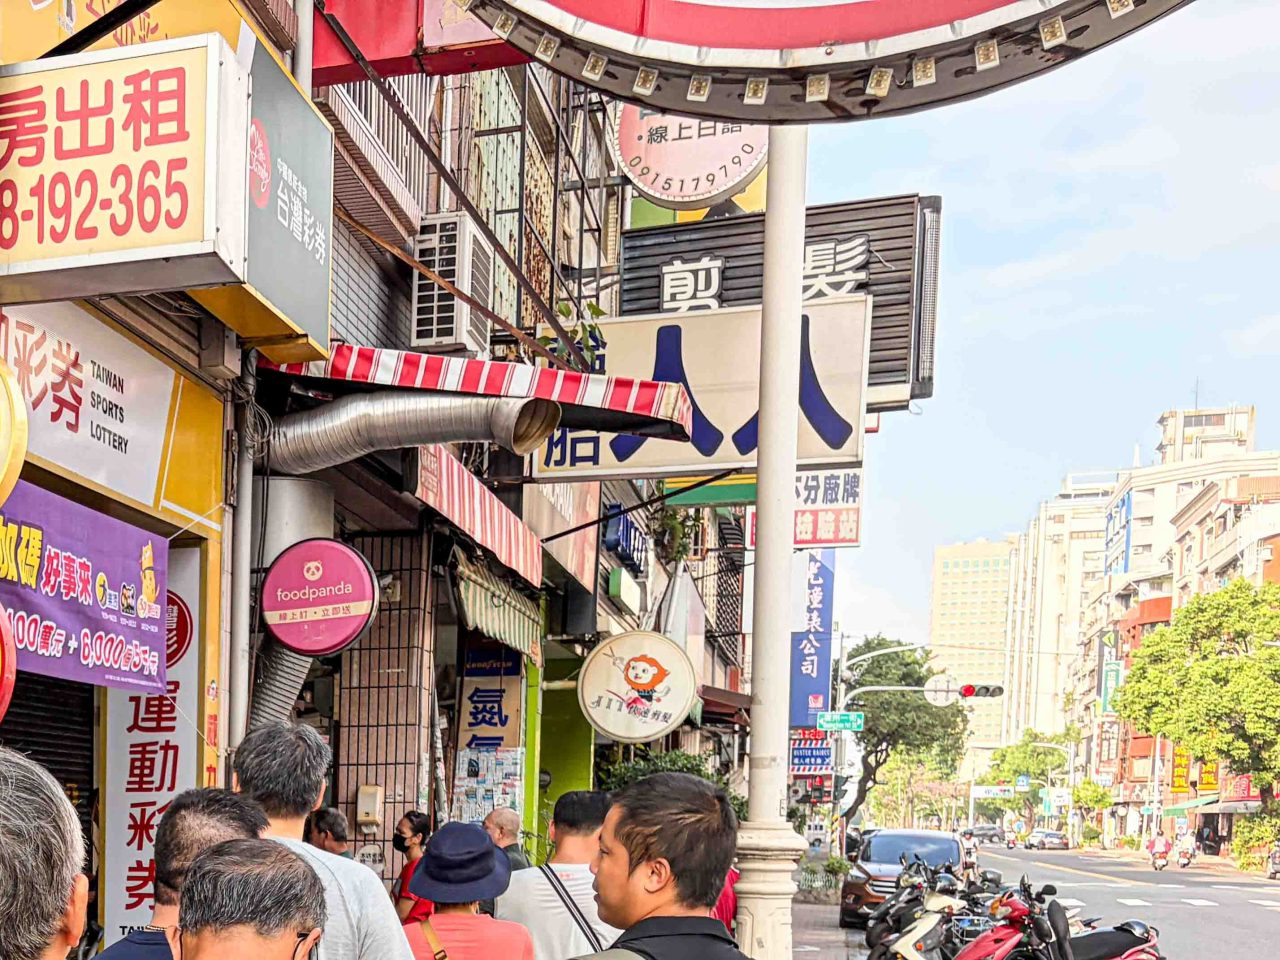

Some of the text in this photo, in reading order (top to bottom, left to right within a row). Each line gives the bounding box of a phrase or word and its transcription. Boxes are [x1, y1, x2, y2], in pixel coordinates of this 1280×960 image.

[629, 143, 754, 193] 0915179790
[277, 179, 326, 265] 台灣彩券
[90, 359, 125, 395] TAIWAN
[90, 391, 125, 424] SPORTS
[89, 419, 129, 455] LOTTERY
[40, 545, 93, 606] 好事來
[277, 581, 352, 602] foodpanda
